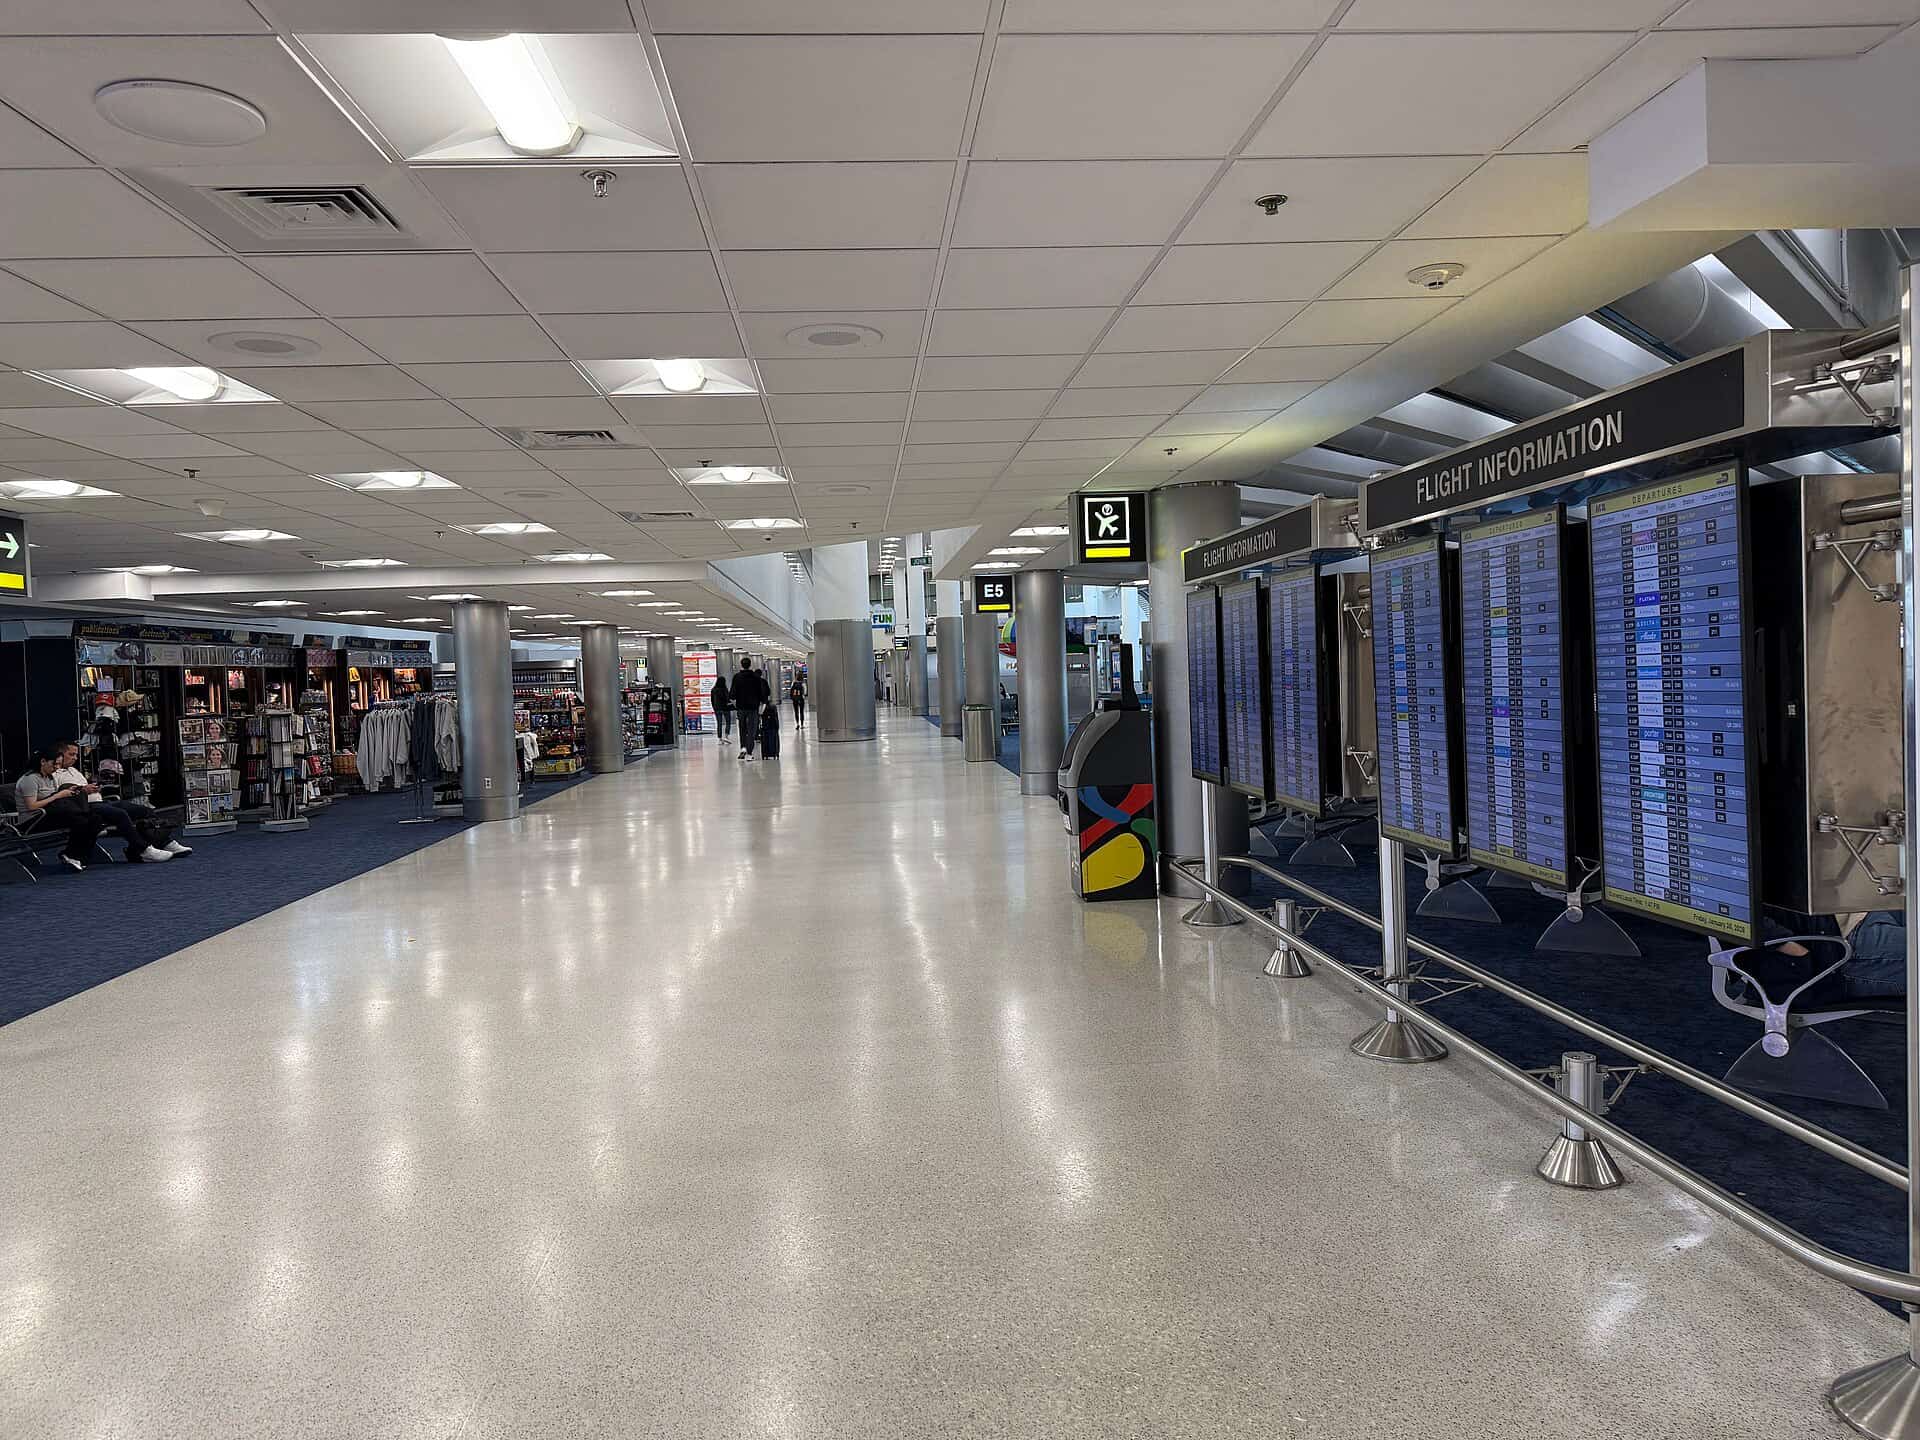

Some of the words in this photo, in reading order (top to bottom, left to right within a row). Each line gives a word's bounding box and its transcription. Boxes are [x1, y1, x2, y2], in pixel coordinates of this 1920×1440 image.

[1417, 462, 1472, 504] FLIGHT
[1479, 411, 1622, 486] INFORMATION
[1632, 485, 1682, 504] DEPARTURES
[1204, 547, 1224, 568] FLIGHT
[1226, 528, 1276, 560] INFORMATION
[984, 584, 1004, 598] E5
[872, 614, 892, 624] FUN
[1644, 730, 1659, 738] porter
